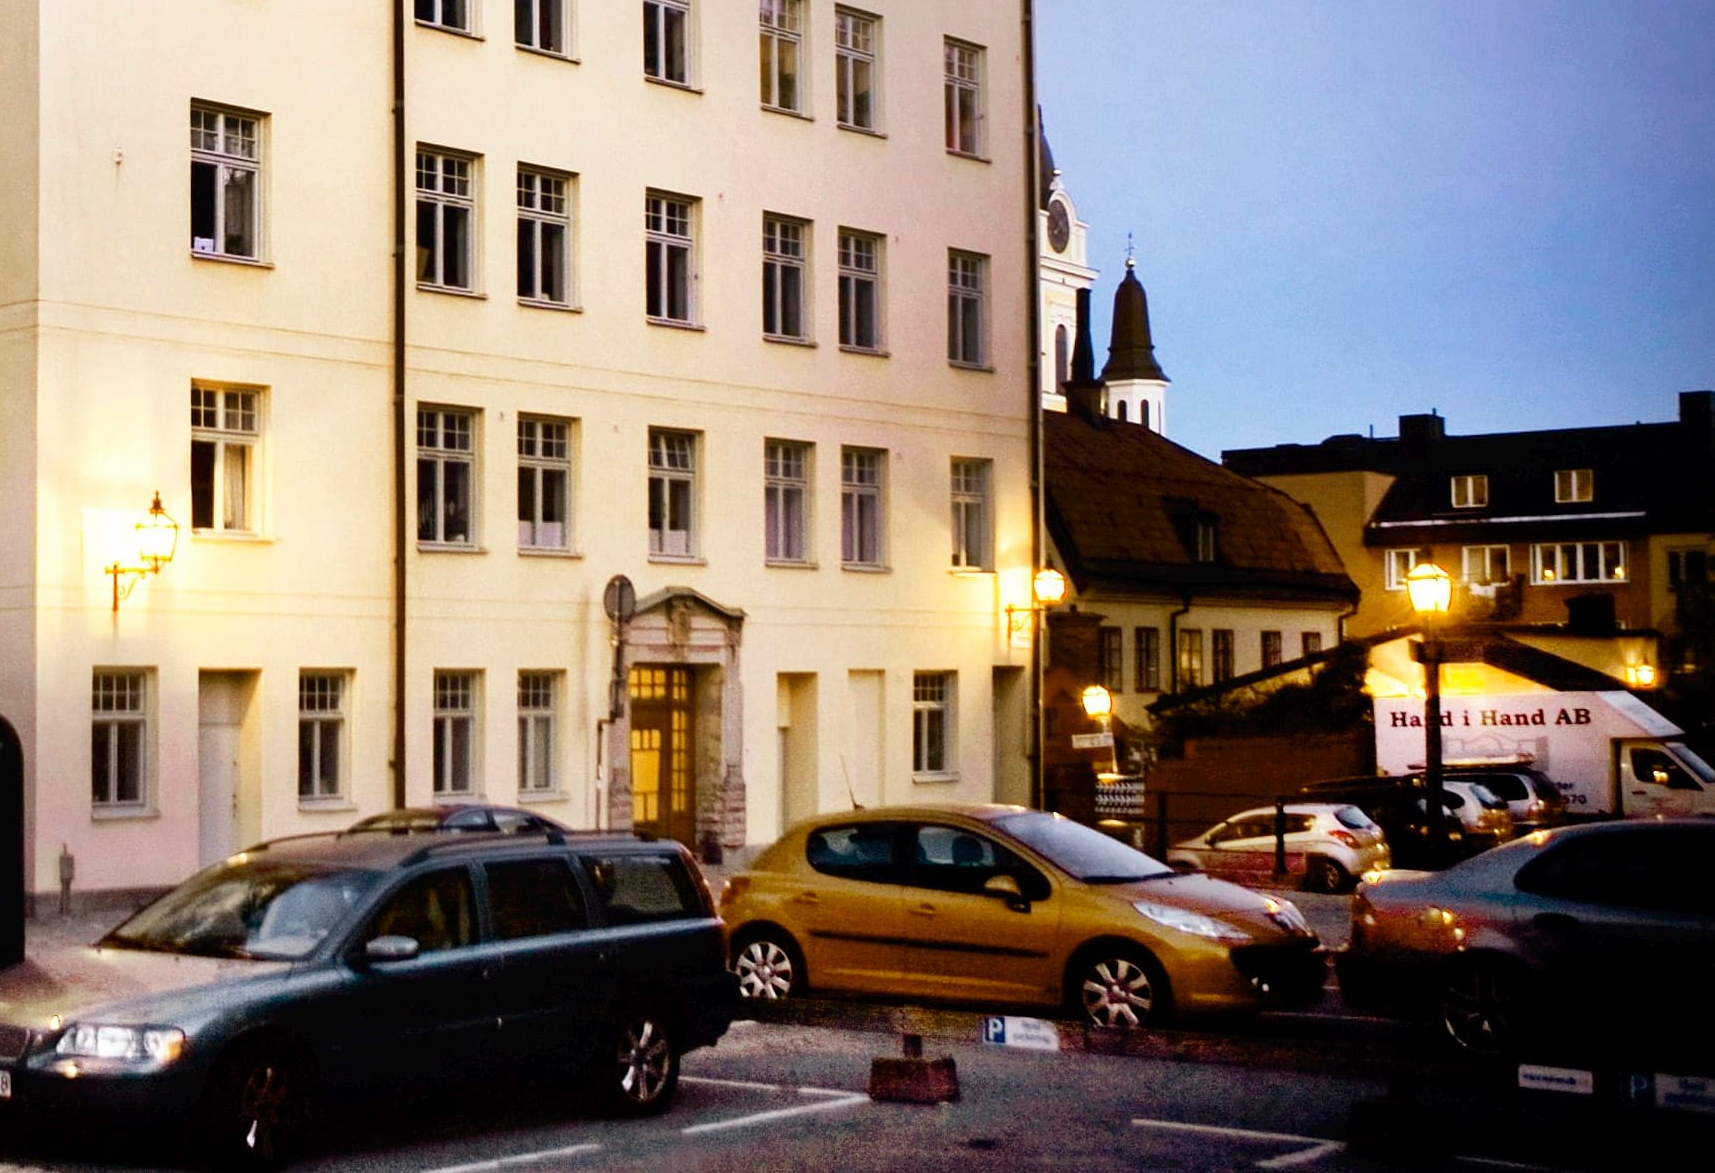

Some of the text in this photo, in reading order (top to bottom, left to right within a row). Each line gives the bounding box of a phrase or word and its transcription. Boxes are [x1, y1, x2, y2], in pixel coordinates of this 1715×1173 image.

[1390, 708, 1592, 727] Had i Hand AB
[988, 1018, 1004, 1040] P
